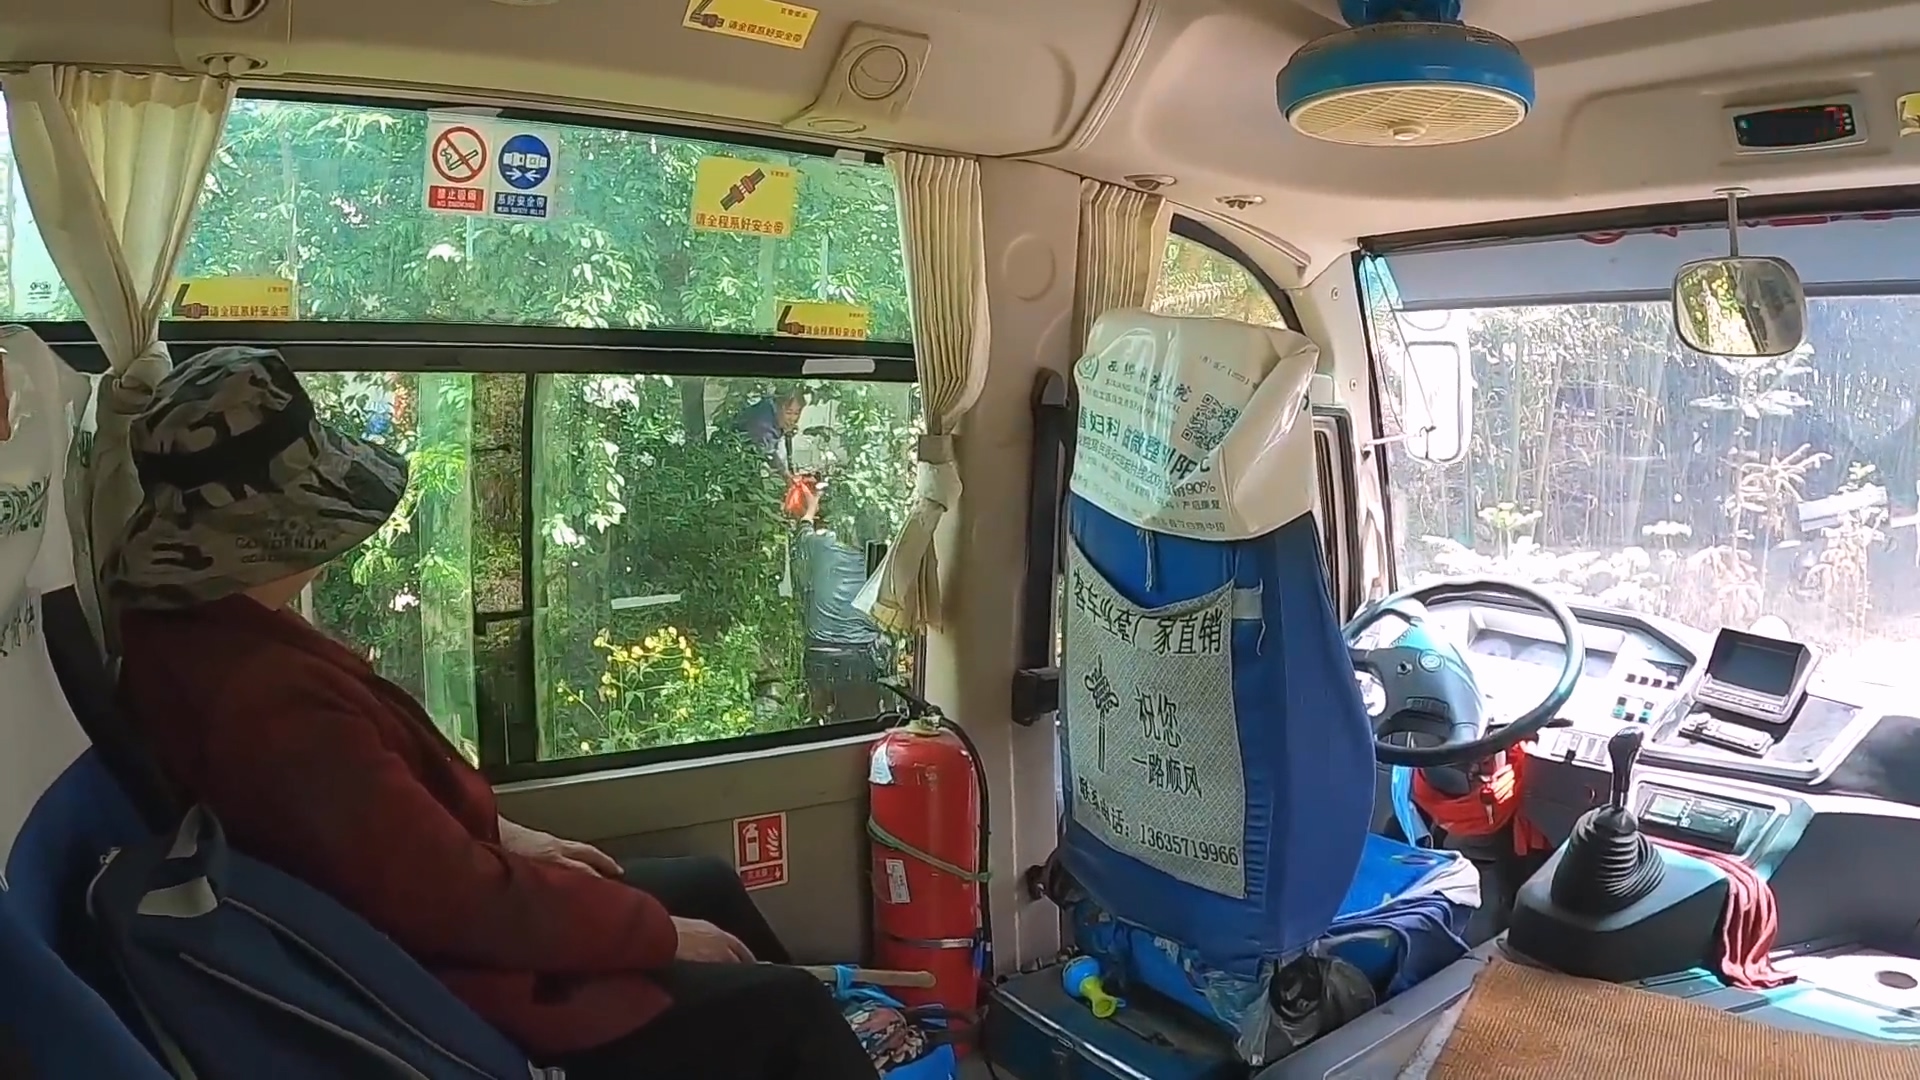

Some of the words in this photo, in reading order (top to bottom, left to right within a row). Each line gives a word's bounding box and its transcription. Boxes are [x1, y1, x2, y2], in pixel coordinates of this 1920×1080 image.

[728, 20, 802, 43] 请全程系好安全带
[696, 212, 784, 234] 请全程系好安全带
[1134, 685, 1182, 748] 祝您
[1131, 753, 1203, 798] 一路顺风
[1140, 823, 1239, 866] 13635719966
